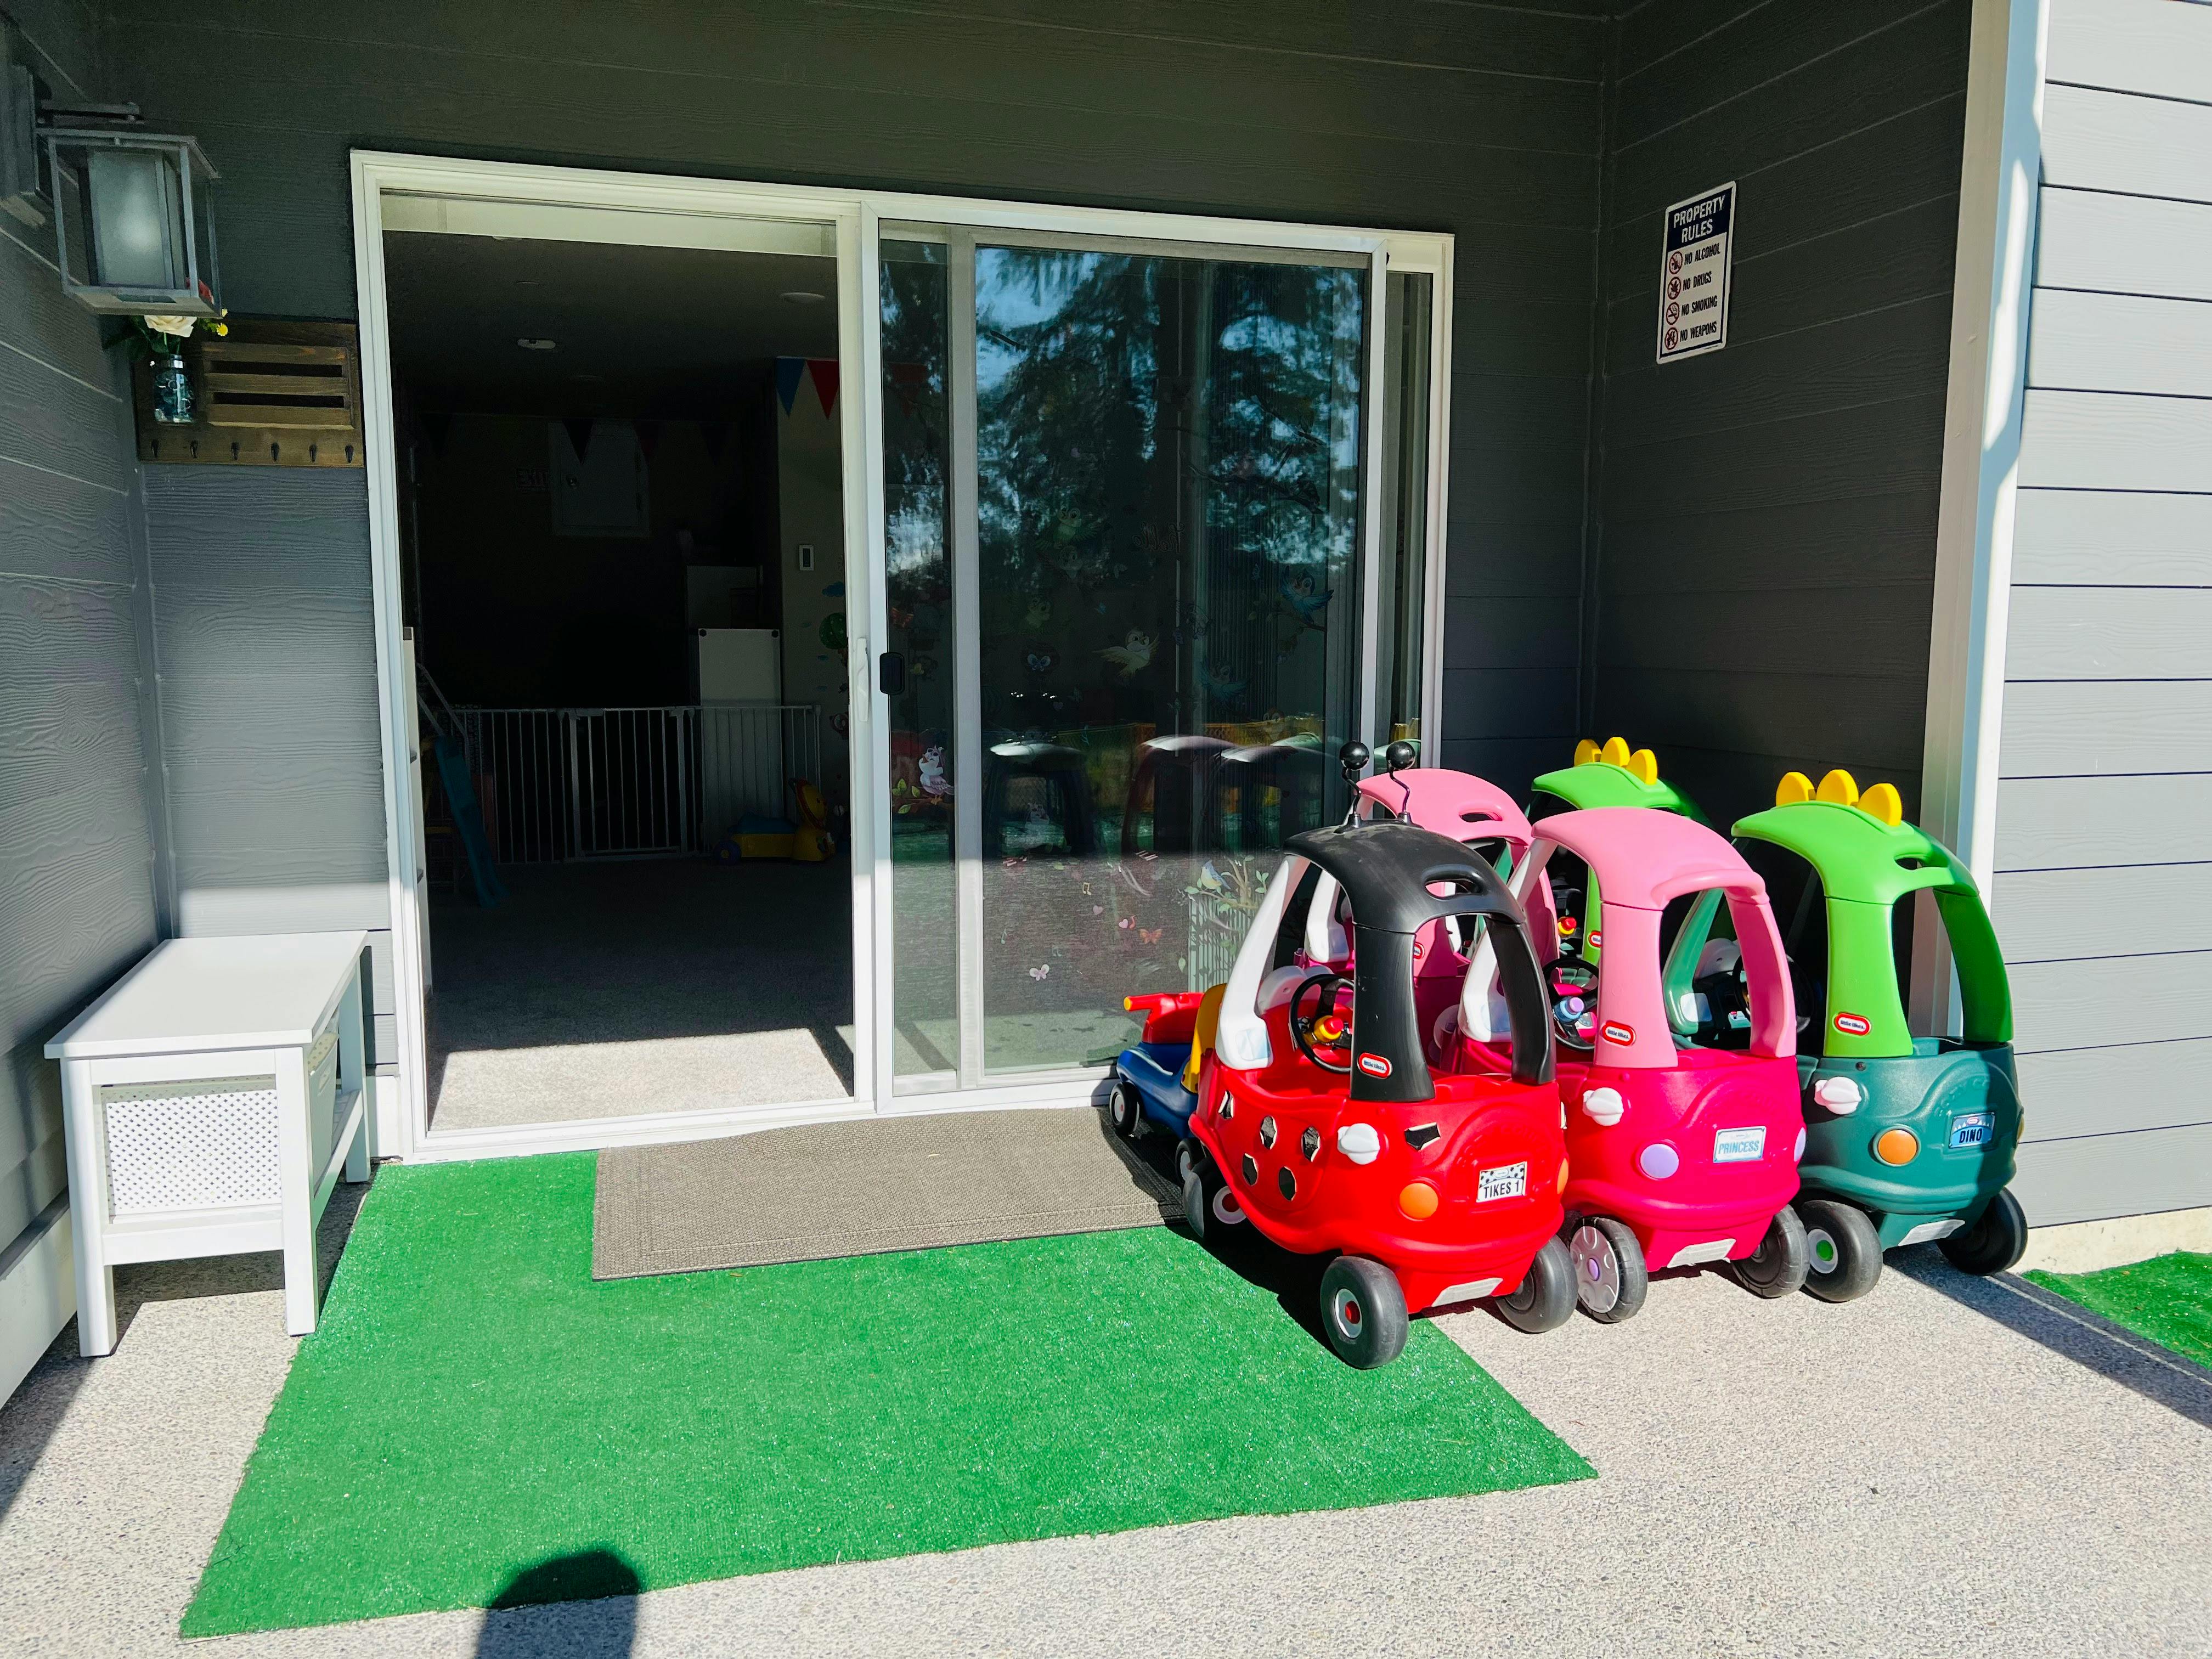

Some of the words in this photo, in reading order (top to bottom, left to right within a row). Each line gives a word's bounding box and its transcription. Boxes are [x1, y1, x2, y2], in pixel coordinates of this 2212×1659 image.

[1673, 194, 1725, 229] PROPERTY
[1681, 219, 1713, 243] RULES
[1684, 253, 1692, 265] NO
[1694, 242, 1720, 263] ALCOHOL
[1683, 279, 1691, 291] NO
[1693, 271, 1712, 288] DRUGS
[1681, 304, 1689, 317] NO
[1691, 295, 1718, 313] SMOKING
[1679, 330, 1688, 342] NO
[1690, 321, 1717, 338] WEAPONS
[1959, 1128, 1983, 1143] DINO
[1718, 1140, 1760, 1154] PRINCESS
[1483, 1181, 1511, 1199] TIKES
[1515, 1180, 1519, 1192] 1
